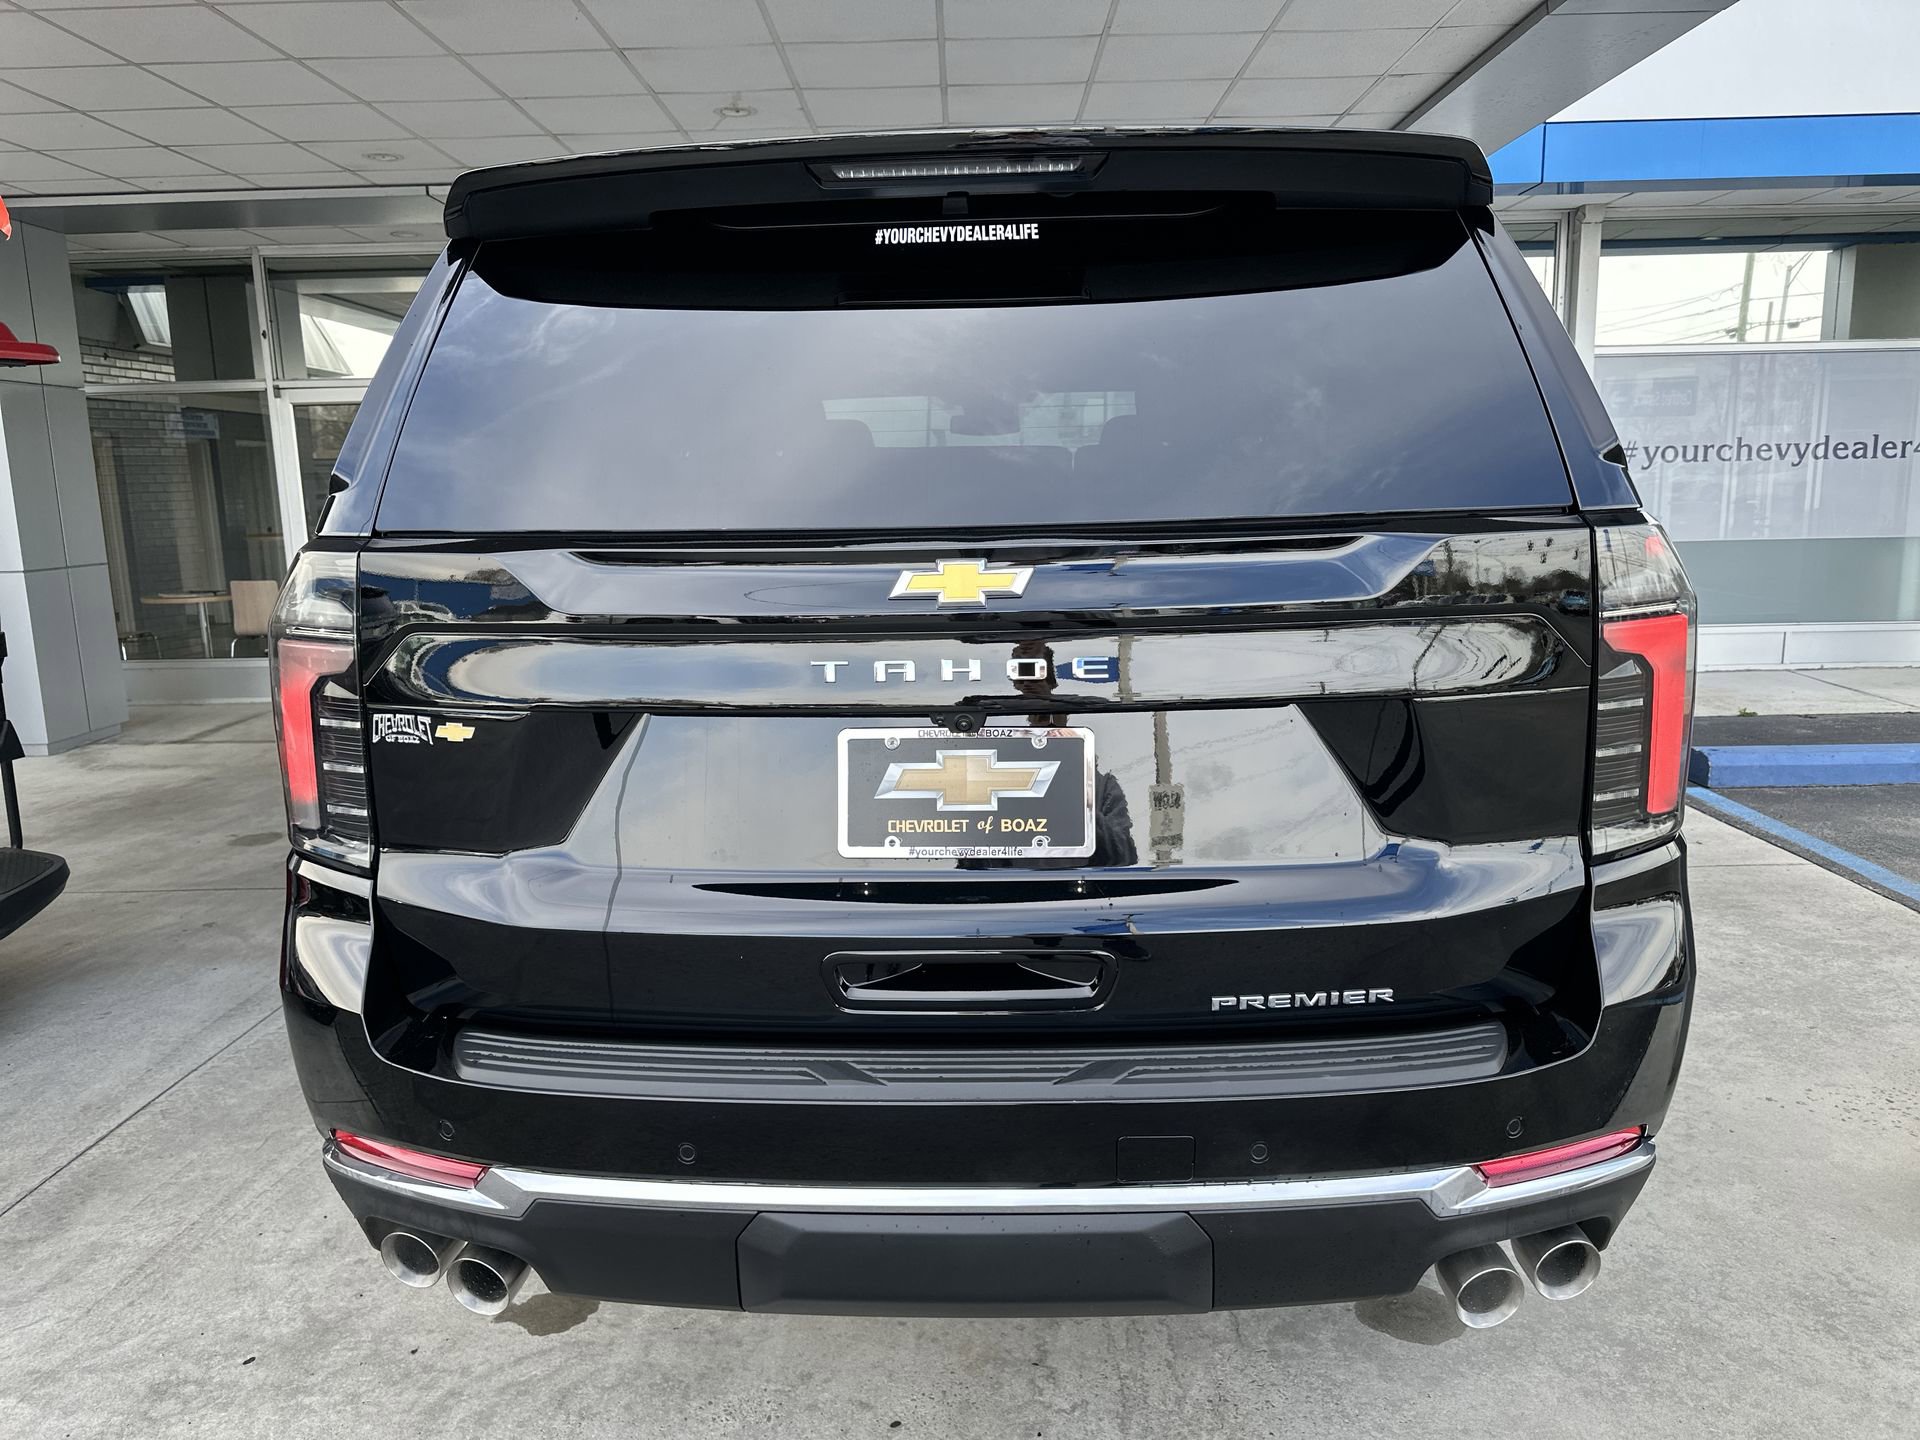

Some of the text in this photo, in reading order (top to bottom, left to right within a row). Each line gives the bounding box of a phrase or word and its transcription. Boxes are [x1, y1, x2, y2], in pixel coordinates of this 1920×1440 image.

[875, 223, 1040, 245] #YOURCHEVYDEALER4LIFE
[810, 657, 1110, 684] TAHOE
[372, 713, 434, 746] CHEVROLET
[985, 729, 1013, 738] BOAZ
[887, 815, 1048, 834] CHEVROLET of BOAZ
[908, 845, 1024, 859] #yourchevydealer4life
[1211, 988, 1395, 1012] PREMIER
